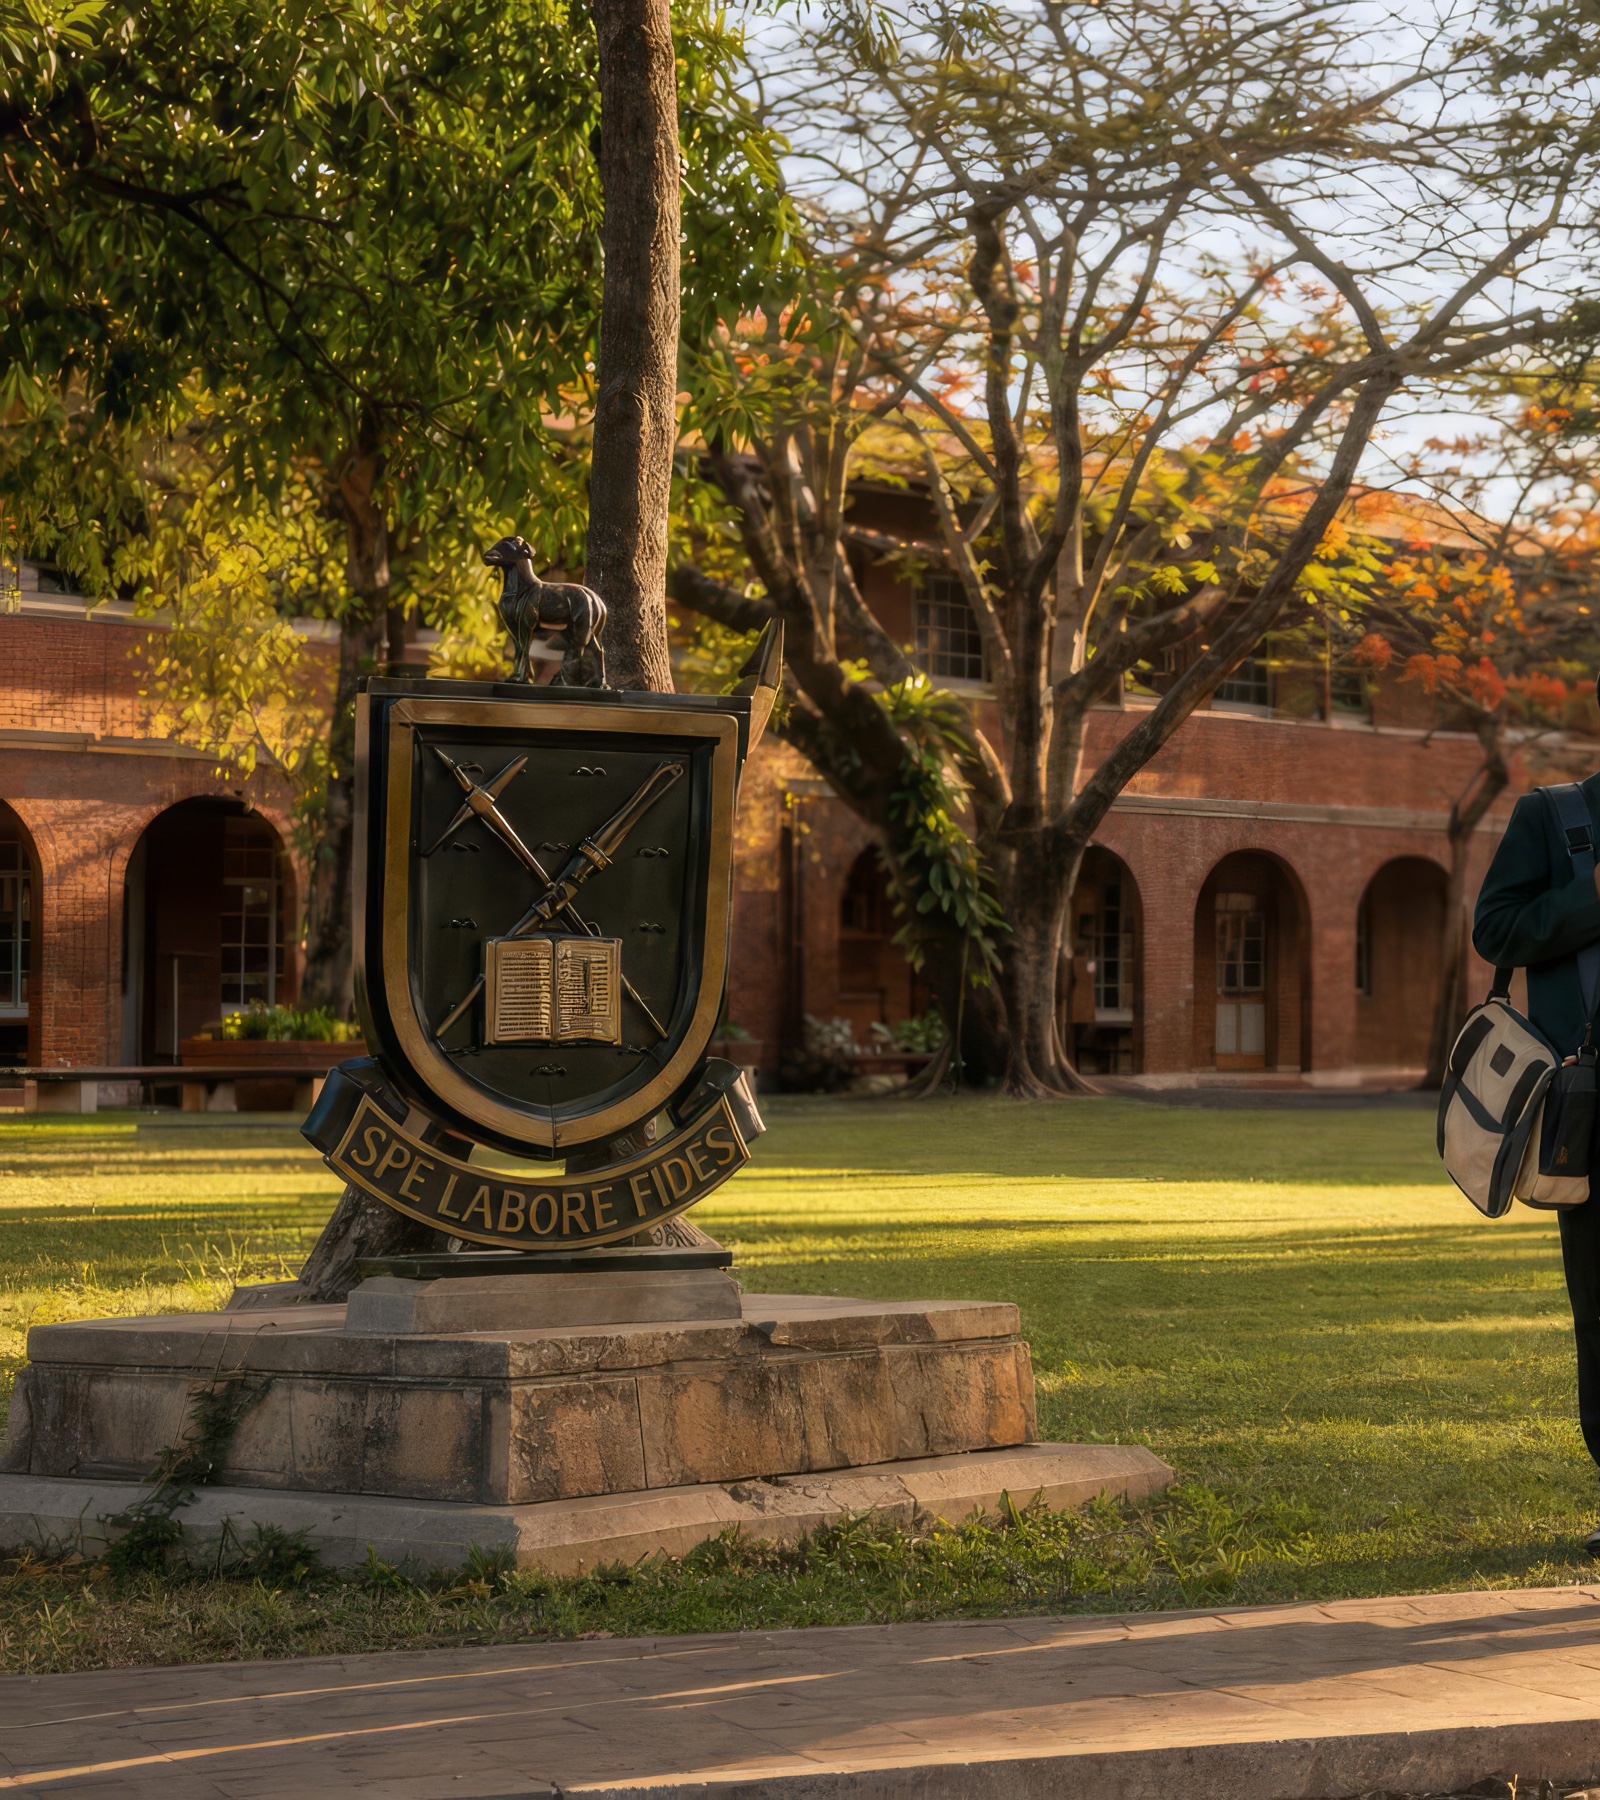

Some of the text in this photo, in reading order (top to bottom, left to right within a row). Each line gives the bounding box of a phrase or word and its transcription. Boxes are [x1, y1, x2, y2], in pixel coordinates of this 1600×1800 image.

[351, 1126, 735, 1235] SPE LABORE FIDES
